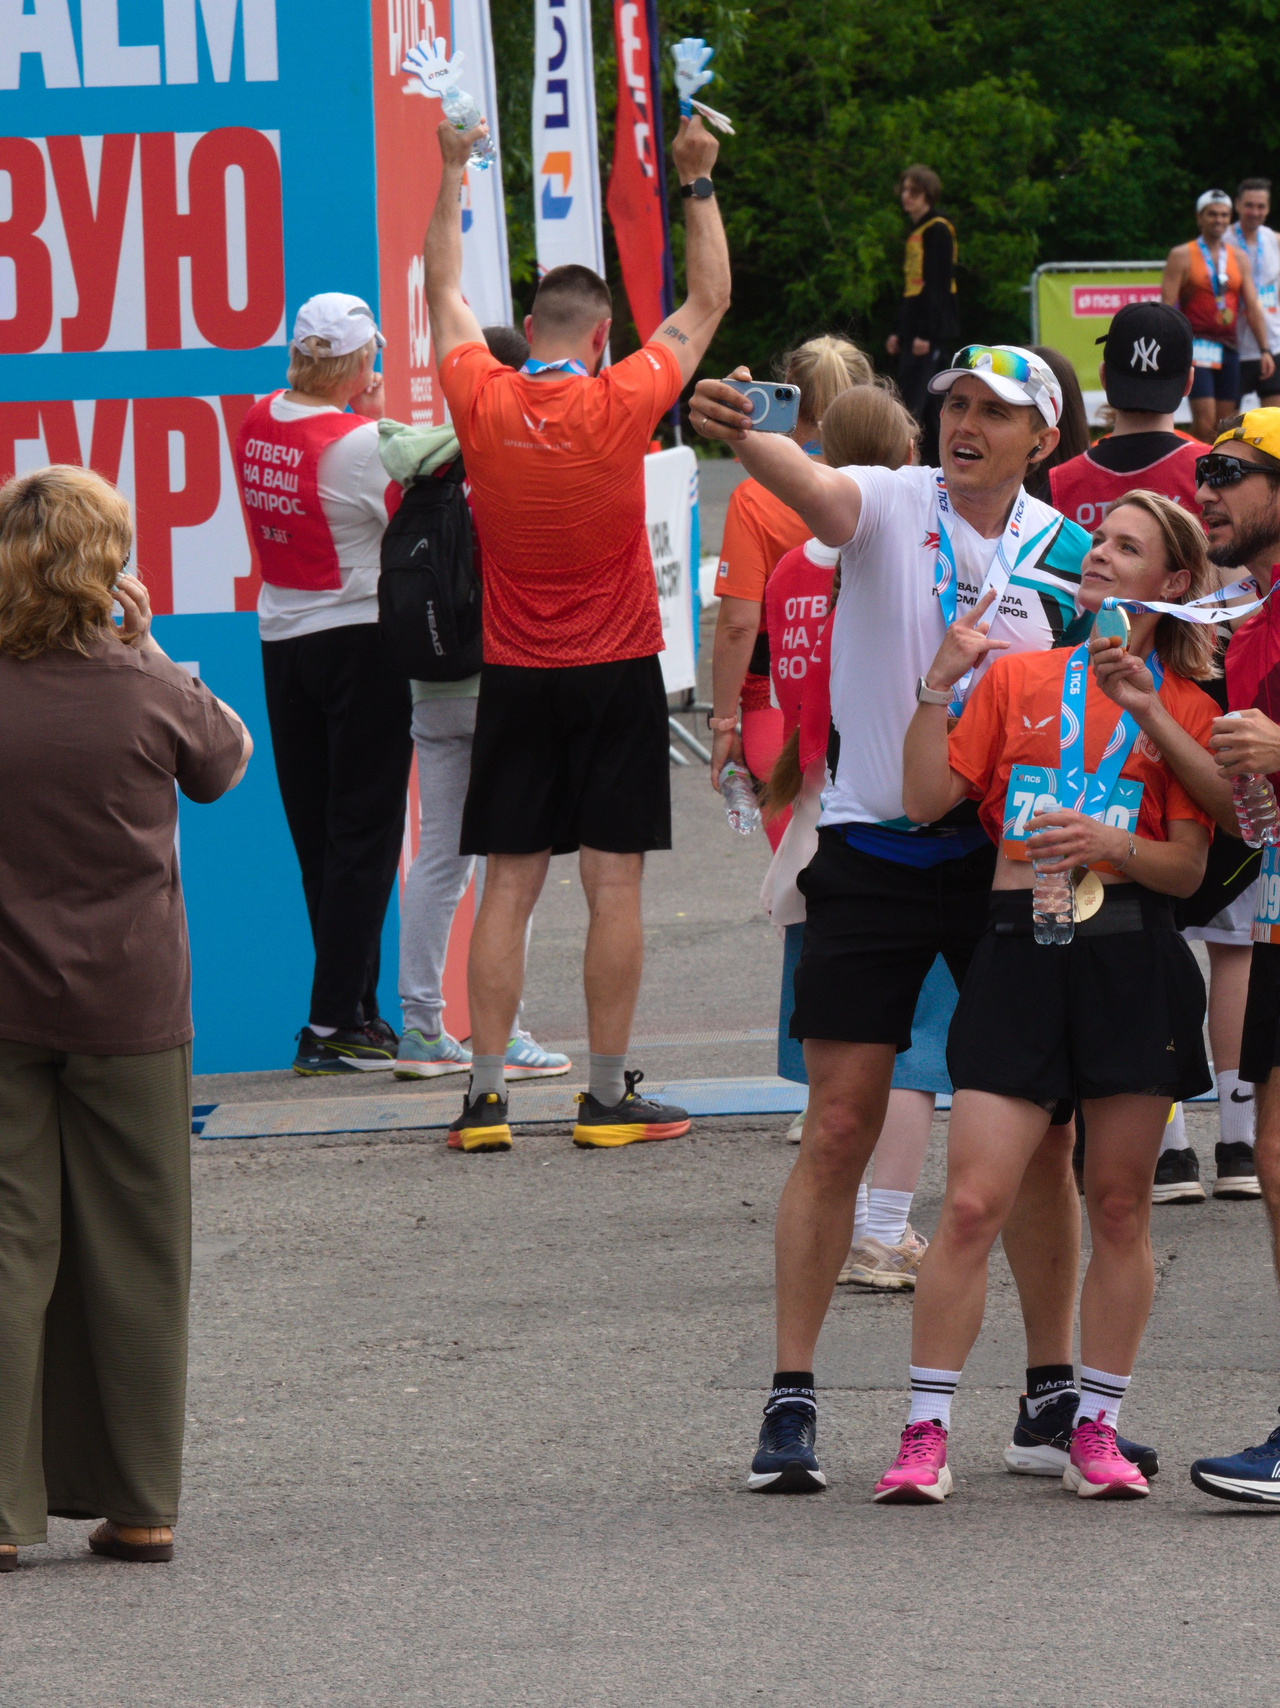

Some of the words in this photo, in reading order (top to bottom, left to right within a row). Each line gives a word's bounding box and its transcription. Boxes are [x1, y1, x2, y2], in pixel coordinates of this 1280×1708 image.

[245, 438, 304, 468] ОТВЕЧУ
[243, 463, 260, 484] НА
[262, 468, 299, 493] ВАШ
[244, 487, 306, 515] ВОПРОС
[937, 490, 949, 513] ПСБ
[1014, 499, 1026, 524] ПСБ
[426, 600, 445, 656] HEAD
[782, 626, 811, 650] НА
[1069, 672, 1081, 695] ПСБ
[1024, 774, 1041, 784] ПСБ
